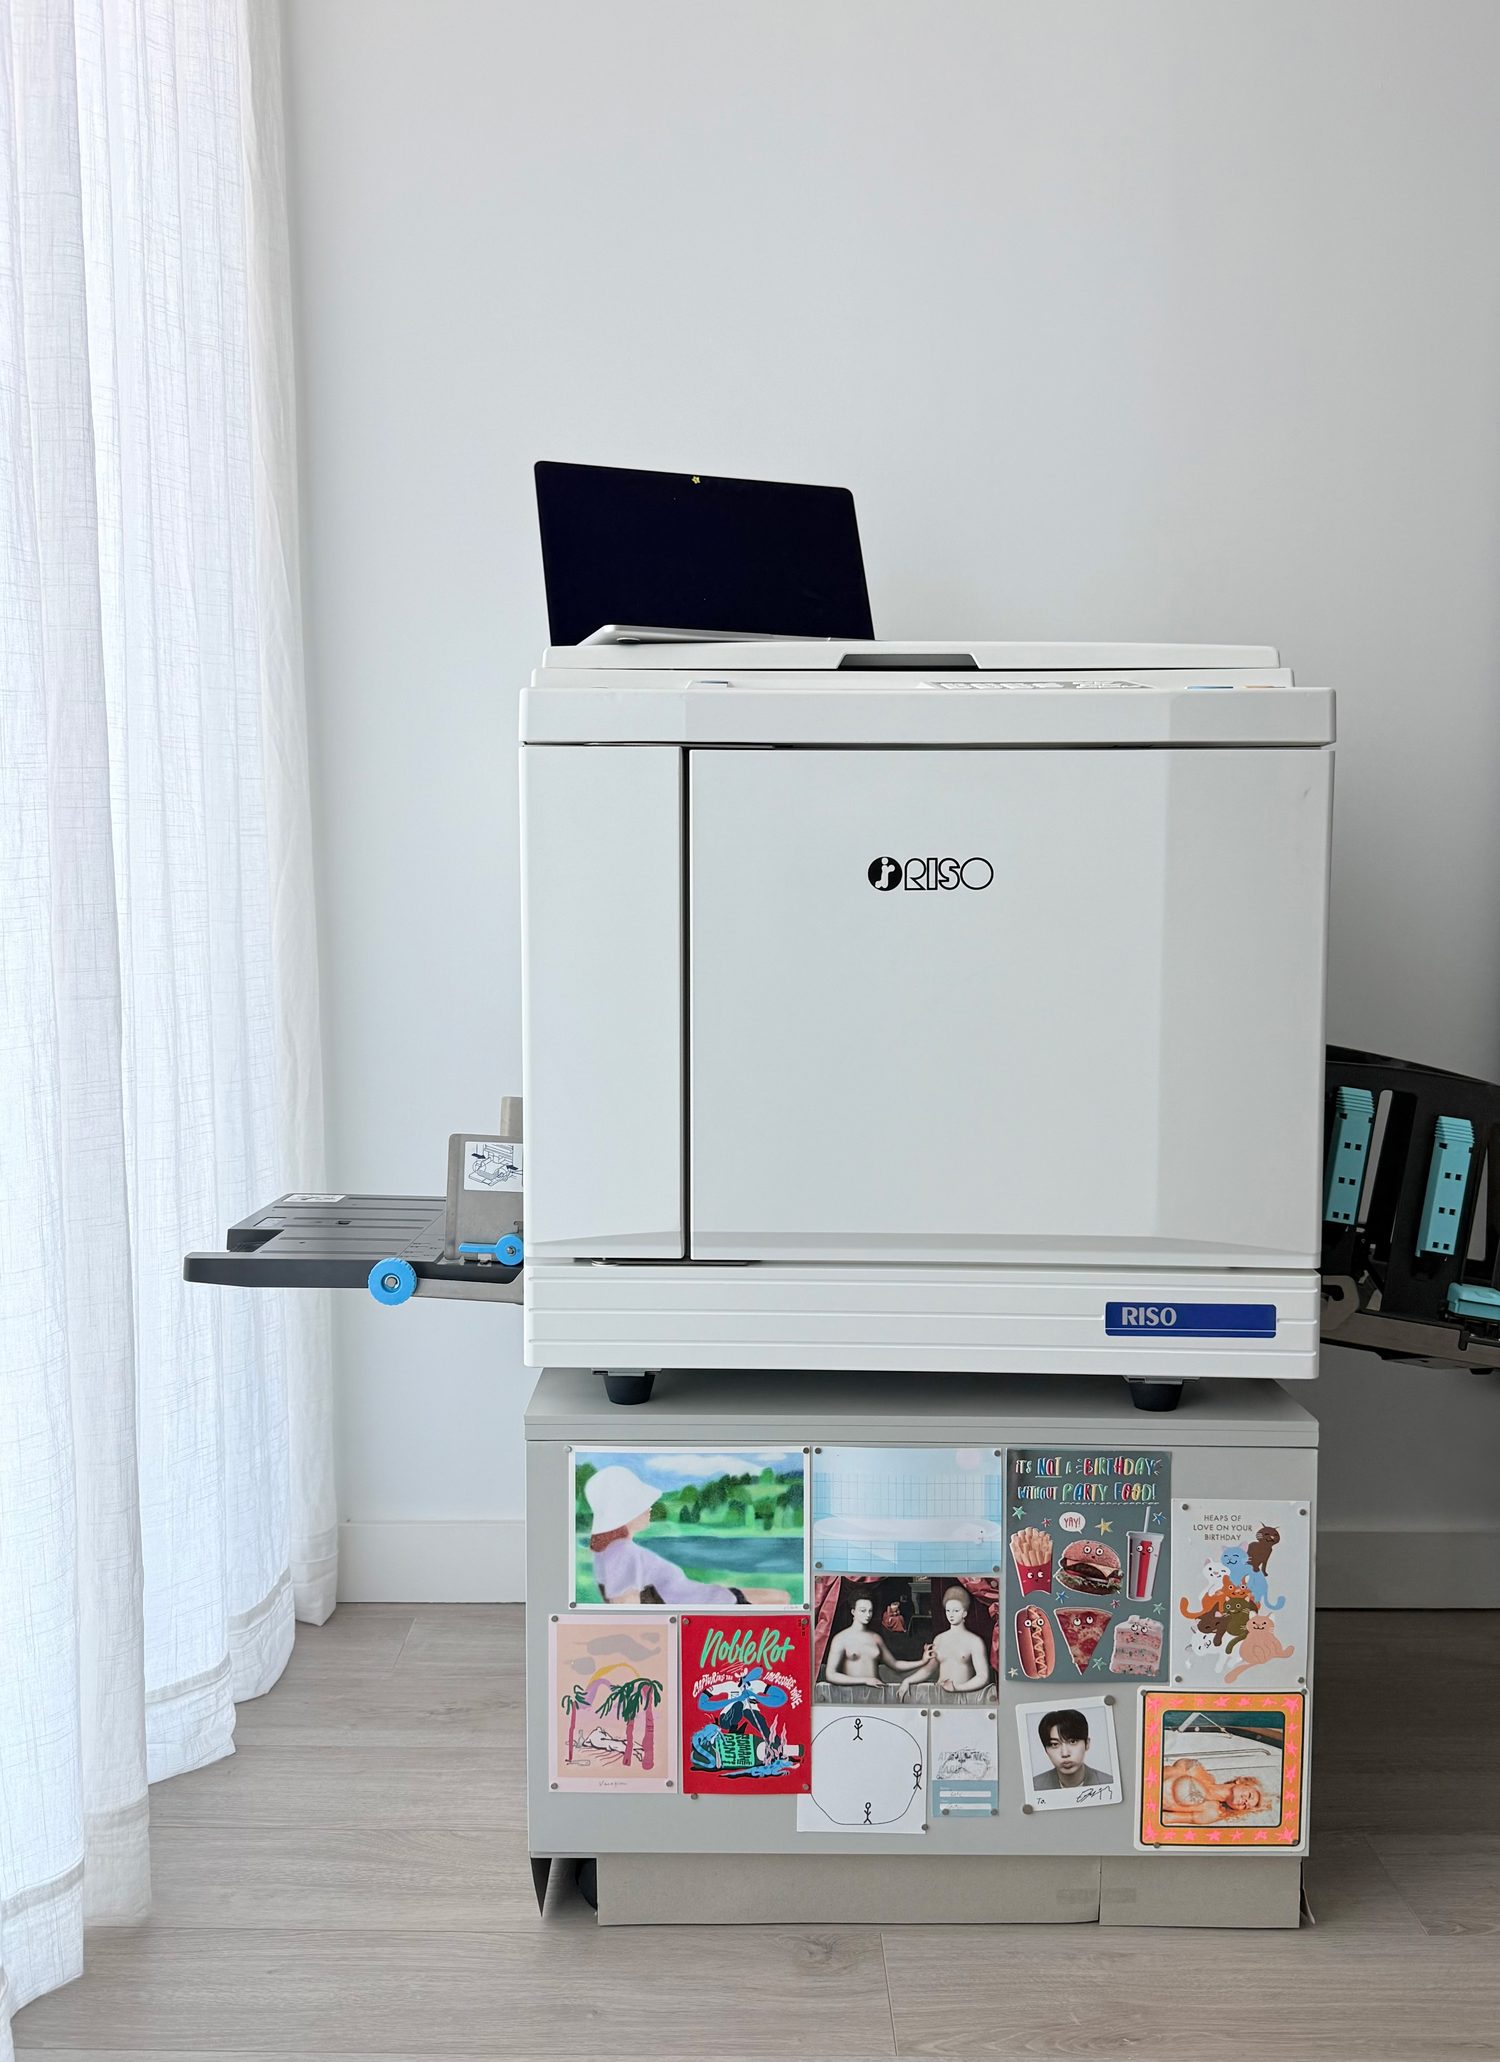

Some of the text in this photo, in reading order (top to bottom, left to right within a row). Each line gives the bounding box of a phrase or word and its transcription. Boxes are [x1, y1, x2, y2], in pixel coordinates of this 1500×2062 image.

[904, 857, 994, 891] RISO
[1121, 1306, 1177, 1327] RISO
[1036, 1456, 1062, 1476] NOT
[1083, 1456, 1155, 1476] BIRTHDAY
[1017, 1481, 1157, 1502] WITHOUT PARTY FOOD!
[1063, 1516, 1081, 1528] YAY!
[1203, 1514, 1242, 1522] HEAPS OF
[1231, 1524, 1253, 1532] YOUR
[1204, 1533, 1241, 1541] BIRTHDAY
